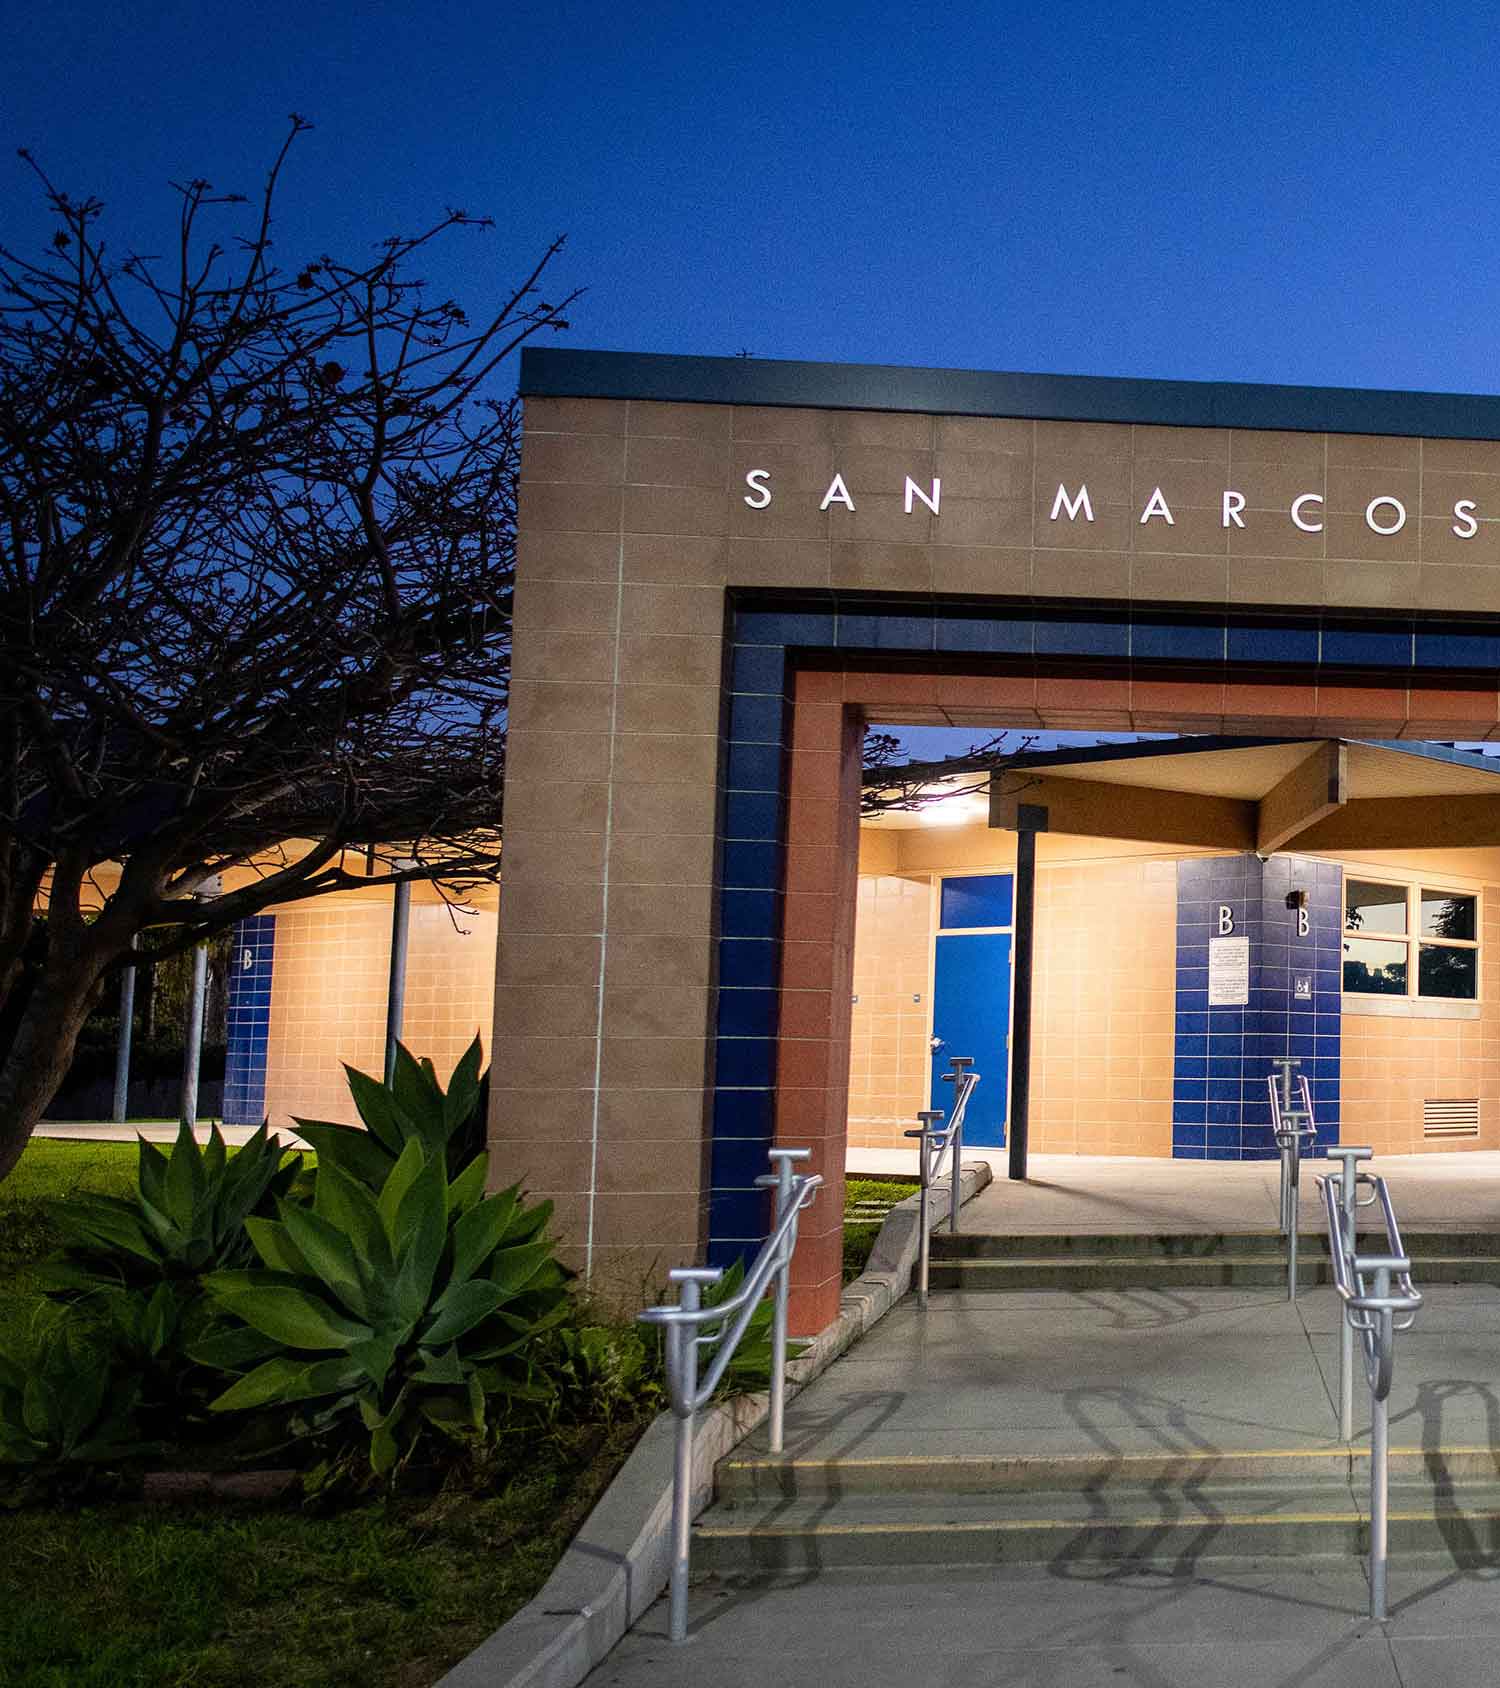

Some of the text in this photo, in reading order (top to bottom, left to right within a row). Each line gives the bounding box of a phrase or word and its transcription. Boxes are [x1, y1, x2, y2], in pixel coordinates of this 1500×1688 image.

[744, 469, 941, 515] SAN
[1050, 483, 1478, 538] MARCOS
[1219, 905, 1234, 935] B
[1298, 907, 1310, 937] B
[243, 949, 252, 970] B
